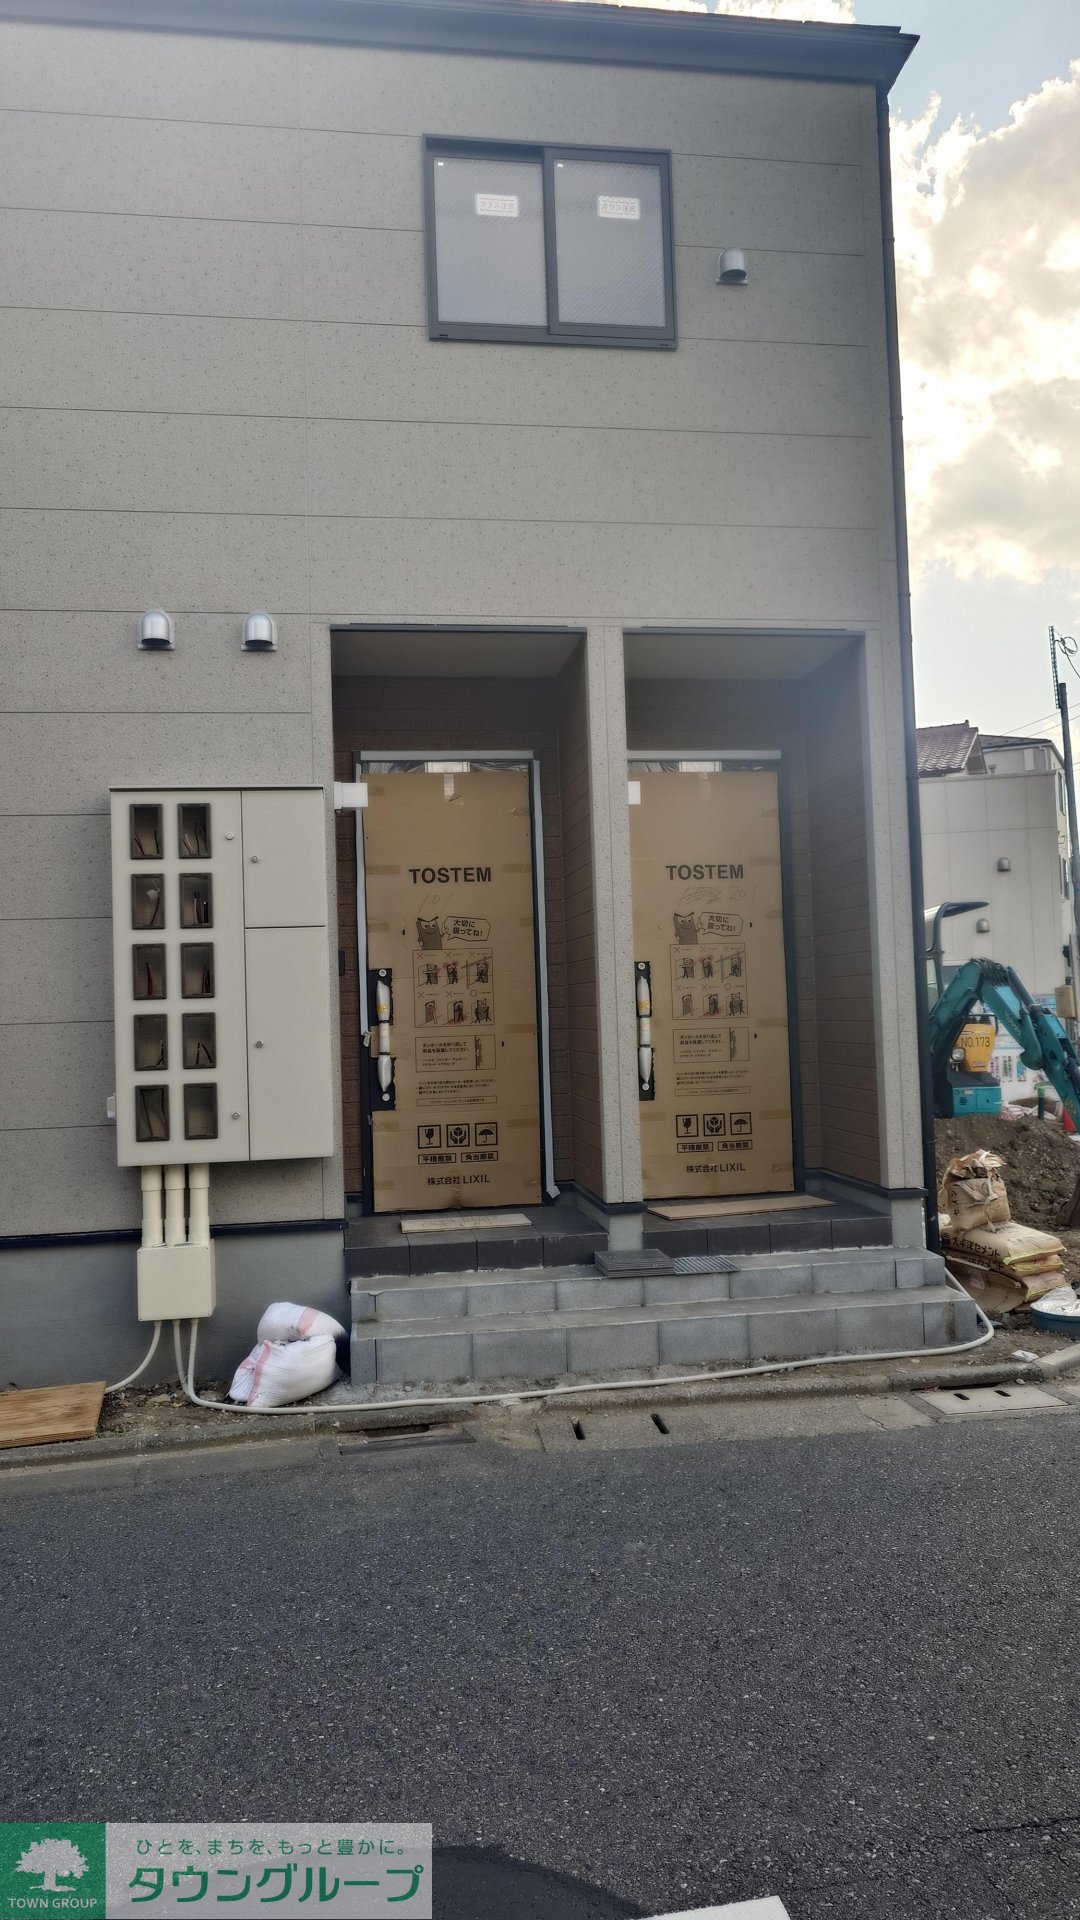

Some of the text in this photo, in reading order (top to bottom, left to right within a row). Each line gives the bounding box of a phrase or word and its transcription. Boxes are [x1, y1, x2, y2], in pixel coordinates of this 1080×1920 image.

[408, 866, 492, 884] TOSTEM
[665, 864, 744, 881] TOSTEM
[453, 919, 476, 928] 大切に
[708, 915, 729, 923] 大切に
[961, 1036, 991, 1048] NO.173
[686, 1163, 746, 1173] 株式会社 LIXIL
[427, 1174, 491, 1186] 株式会社 LIXIL
